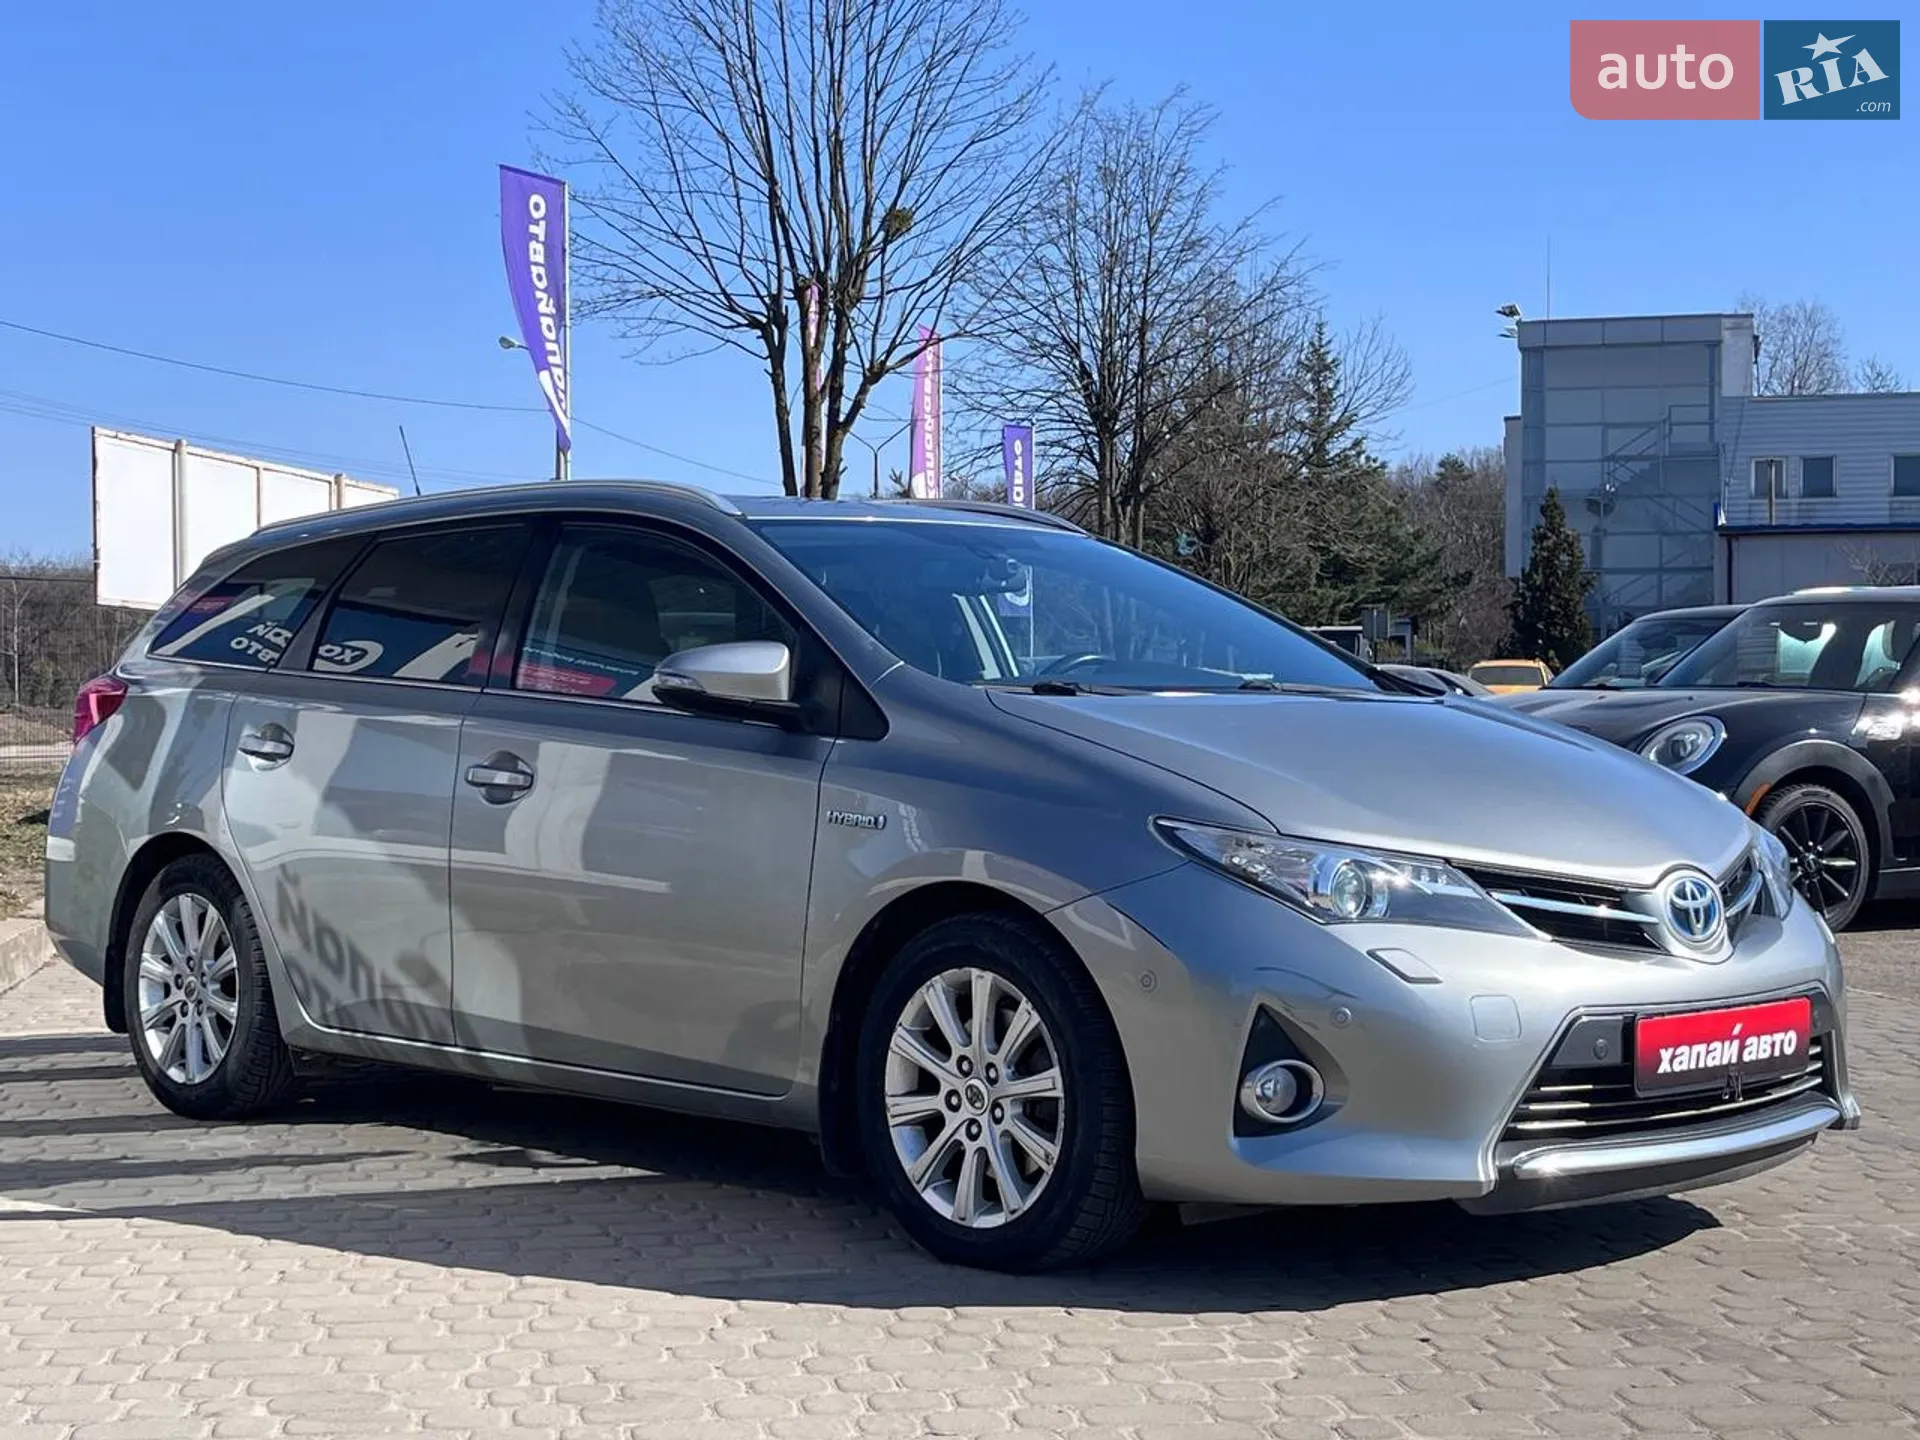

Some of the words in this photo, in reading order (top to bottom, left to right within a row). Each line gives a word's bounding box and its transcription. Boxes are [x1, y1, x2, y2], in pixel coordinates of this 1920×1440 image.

[826, 810, 876, 828] HYBRID
[1657, 1022, 1740, 1074] хапай
[1742, 1030, 1797, 1063] авто
